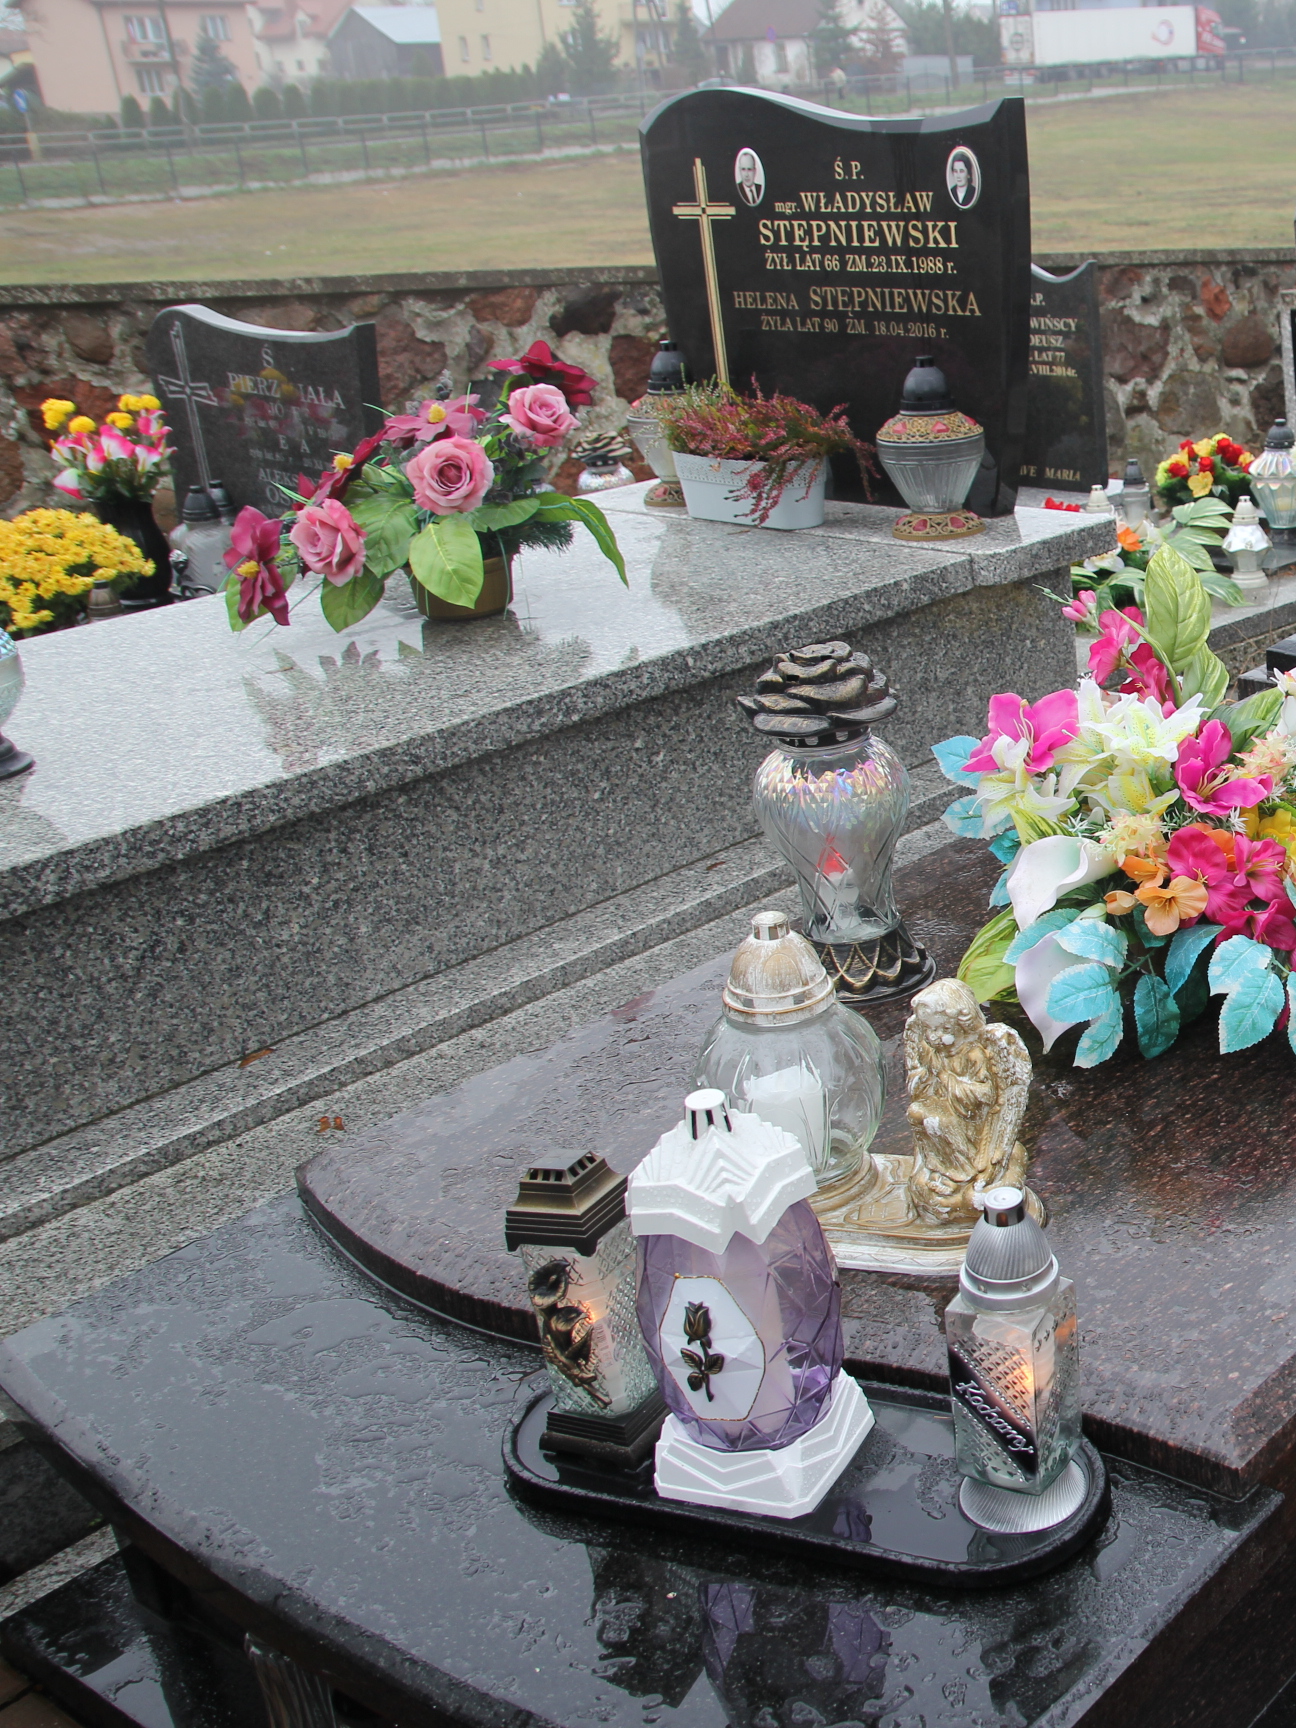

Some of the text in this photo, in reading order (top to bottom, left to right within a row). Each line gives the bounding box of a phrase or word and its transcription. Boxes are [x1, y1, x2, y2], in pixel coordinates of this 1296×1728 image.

[800, 191, 934, 213] WŁADYSŁAW
[758, 219, 959, 251] STĘPNIEWSKI
[765, 250, 792, 270] ŻYŁ
[795, 253, 822, 271] LAT
[824, 254, 840, 271] 66
[946, 261, 957, 274] r.
[733, 286, 982, 316] HELENA STĘPNIEWSKA
[761, 313, 949, 338] ŻYŁA LAT 90 ZM. 18.04.2016 r.
[1034, 350, 1066, 362] LAT 77
